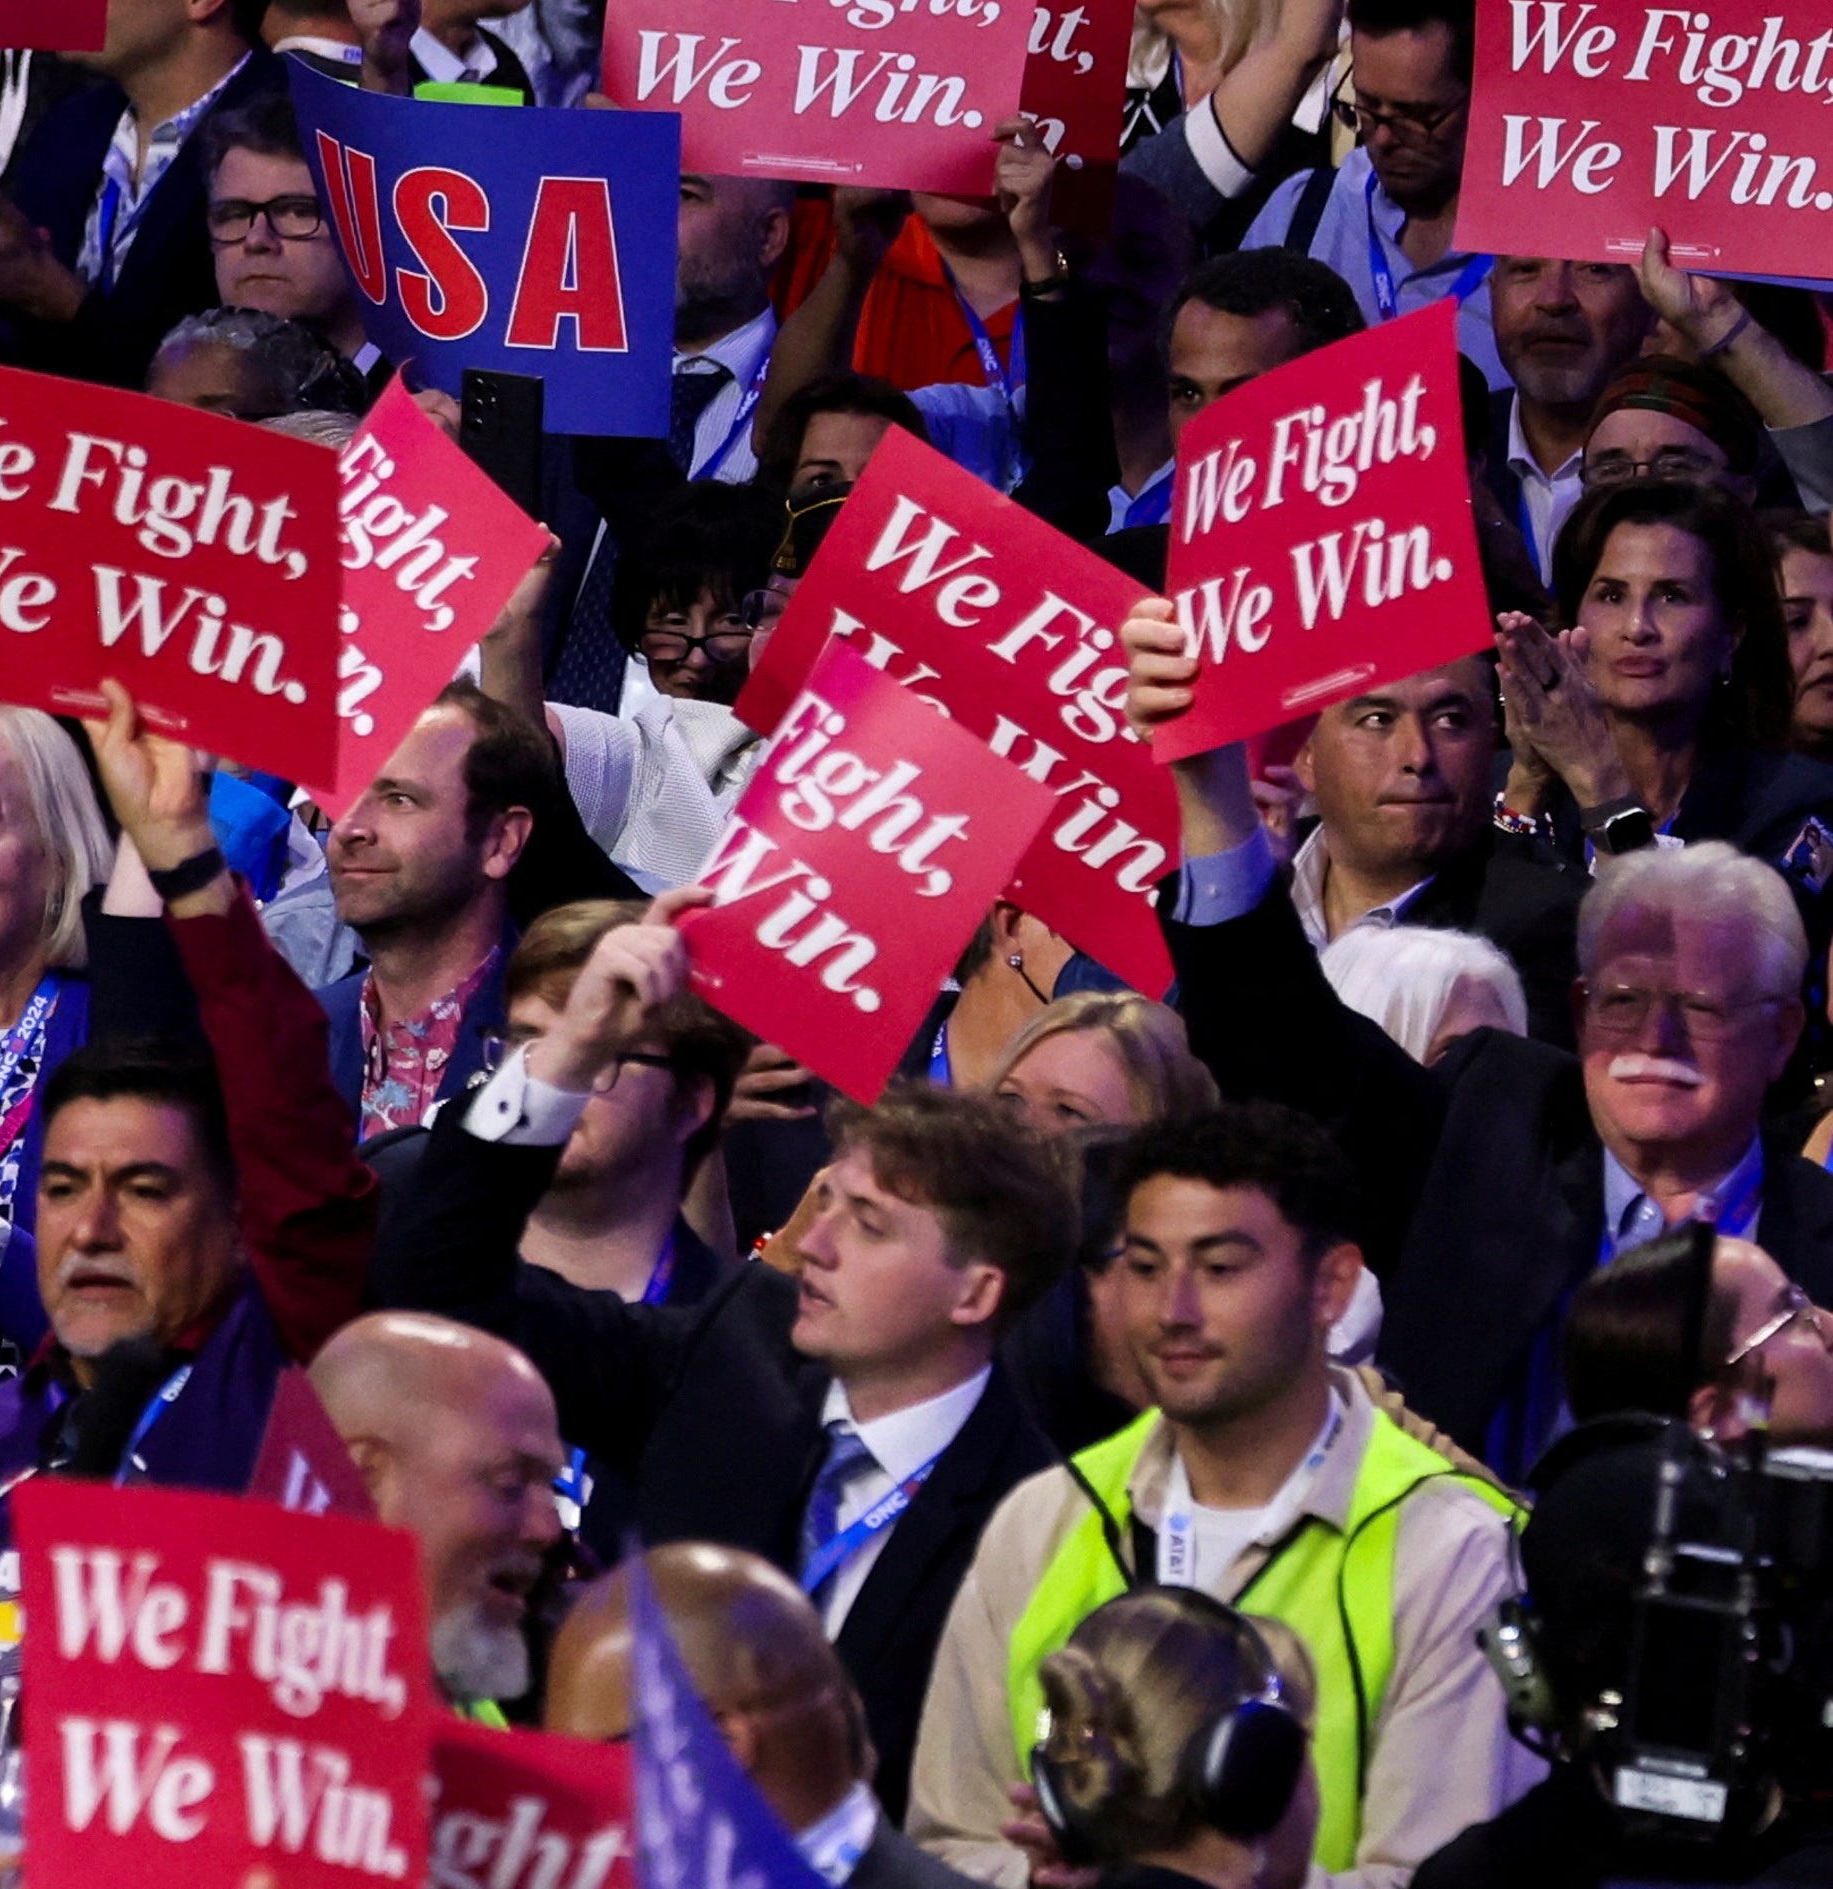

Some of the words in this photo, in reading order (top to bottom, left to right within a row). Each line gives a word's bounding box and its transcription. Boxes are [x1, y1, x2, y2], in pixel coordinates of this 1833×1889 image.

[638, 30, 759, 108] We
[795, 45, 982, 128] Win.
[1509, 0, 1616, 77] We
[1503, 115, 1621, 193] We
[312, 129, 628, 352] USA
[48, 433, 307, 579] Fight,
[1184, 440, 1256, 543] We
[1262, 375, 1436, 509] Fight,
[92, 565, 306, 703] Win.
[1175, 567, 1273, 674] We
[1290, 518, 1452, 629] Win.
[17, 995, 48, 1041] 2024
[53, 1547, 186, 1668] We
[198, 1561, 406, 1716] Fight,
[61, 1718, 213, 1841] We
[240, 1734, 406, 1878] Win.
